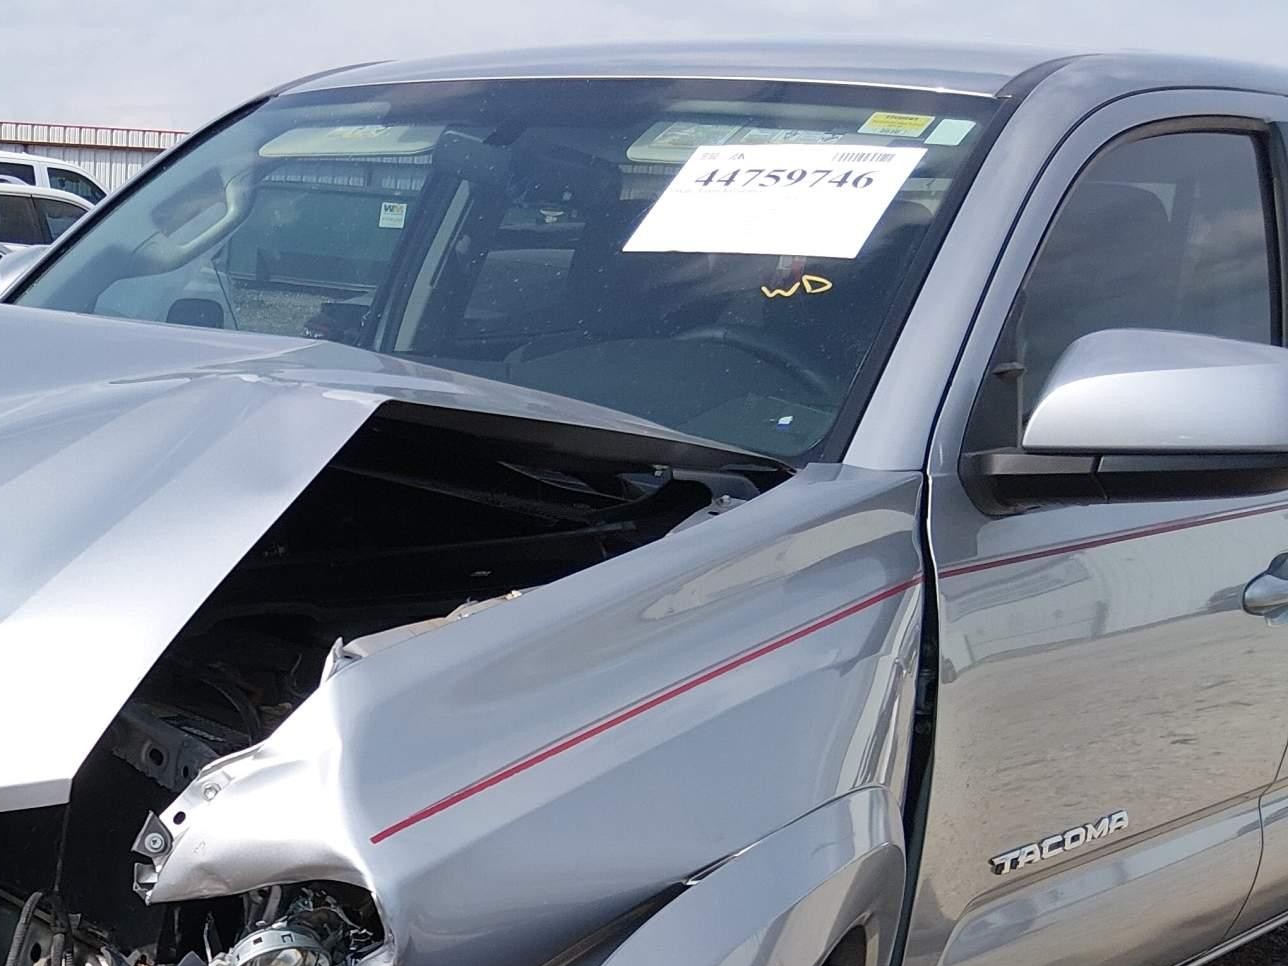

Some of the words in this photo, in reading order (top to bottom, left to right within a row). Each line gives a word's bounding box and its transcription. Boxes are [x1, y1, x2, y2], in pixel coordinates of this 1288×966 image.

[694, 167, 878, 189] 44759746
[760, 274, 833, 298] WD
[989, 809, 1129, 875] TACOMA
